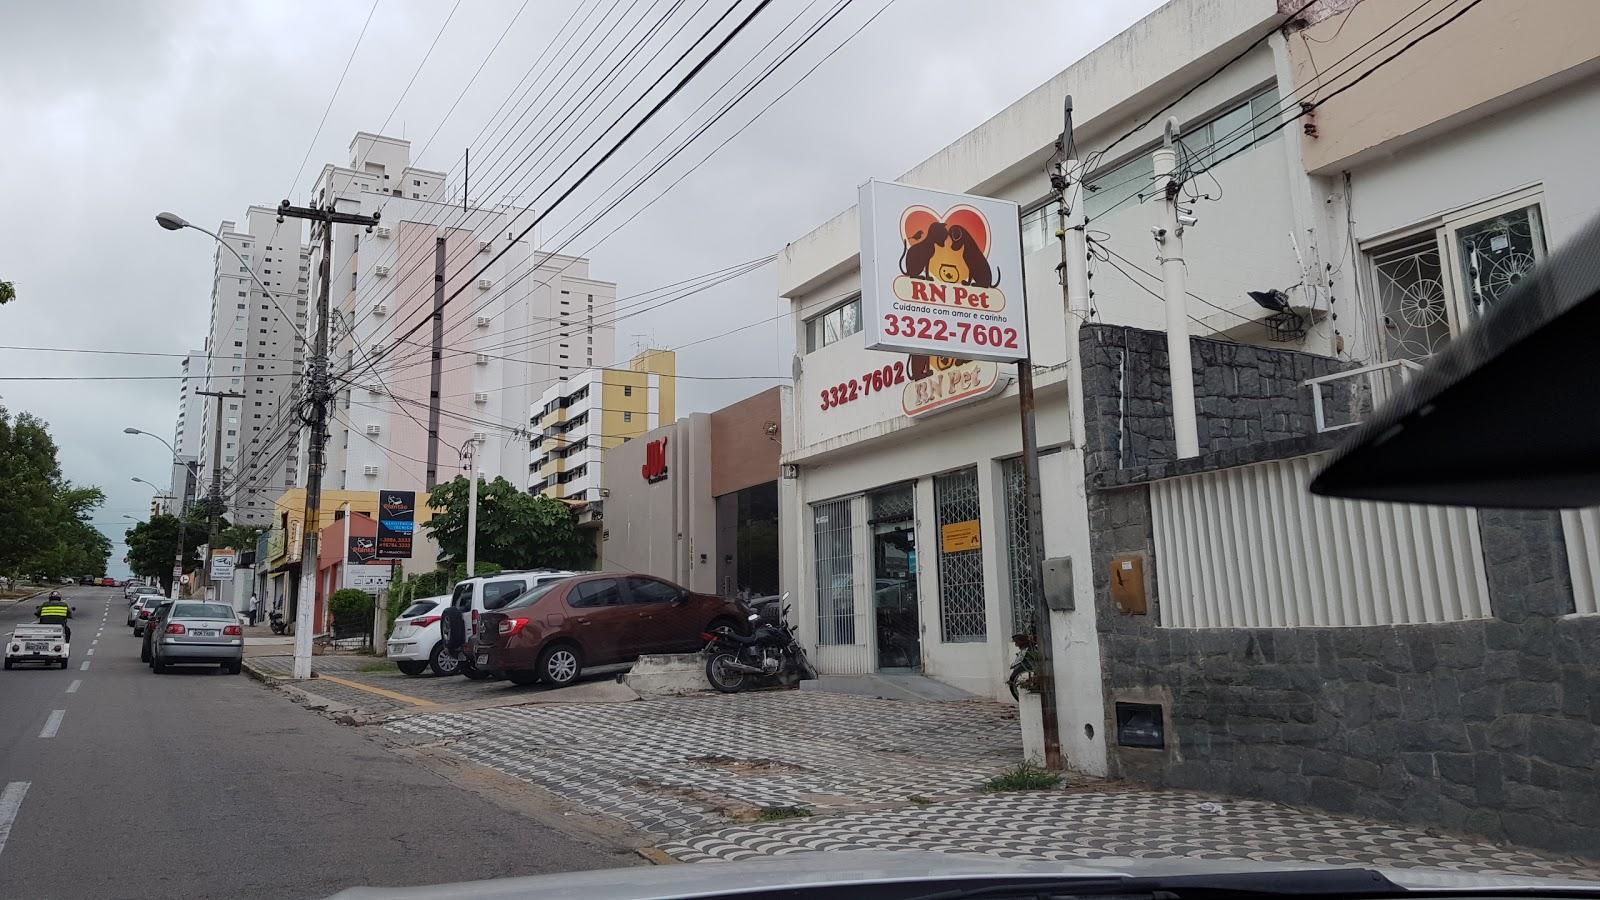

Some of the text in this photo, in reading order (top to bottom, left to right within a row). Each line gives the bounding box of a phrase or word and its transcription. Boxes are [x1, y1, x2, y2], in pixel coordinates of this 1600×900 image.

[911, 280, 990, 309] RN Pet
[892, 302, 931, 314] Cuidando
[932, 308, 950, 316] com
[951, 311, 972, 319] amor
[979, 314, 1008, 323] carinho
[884, 313, 1018, 349] 3322-7602
[914, 365, 981, 406] RN Pet
